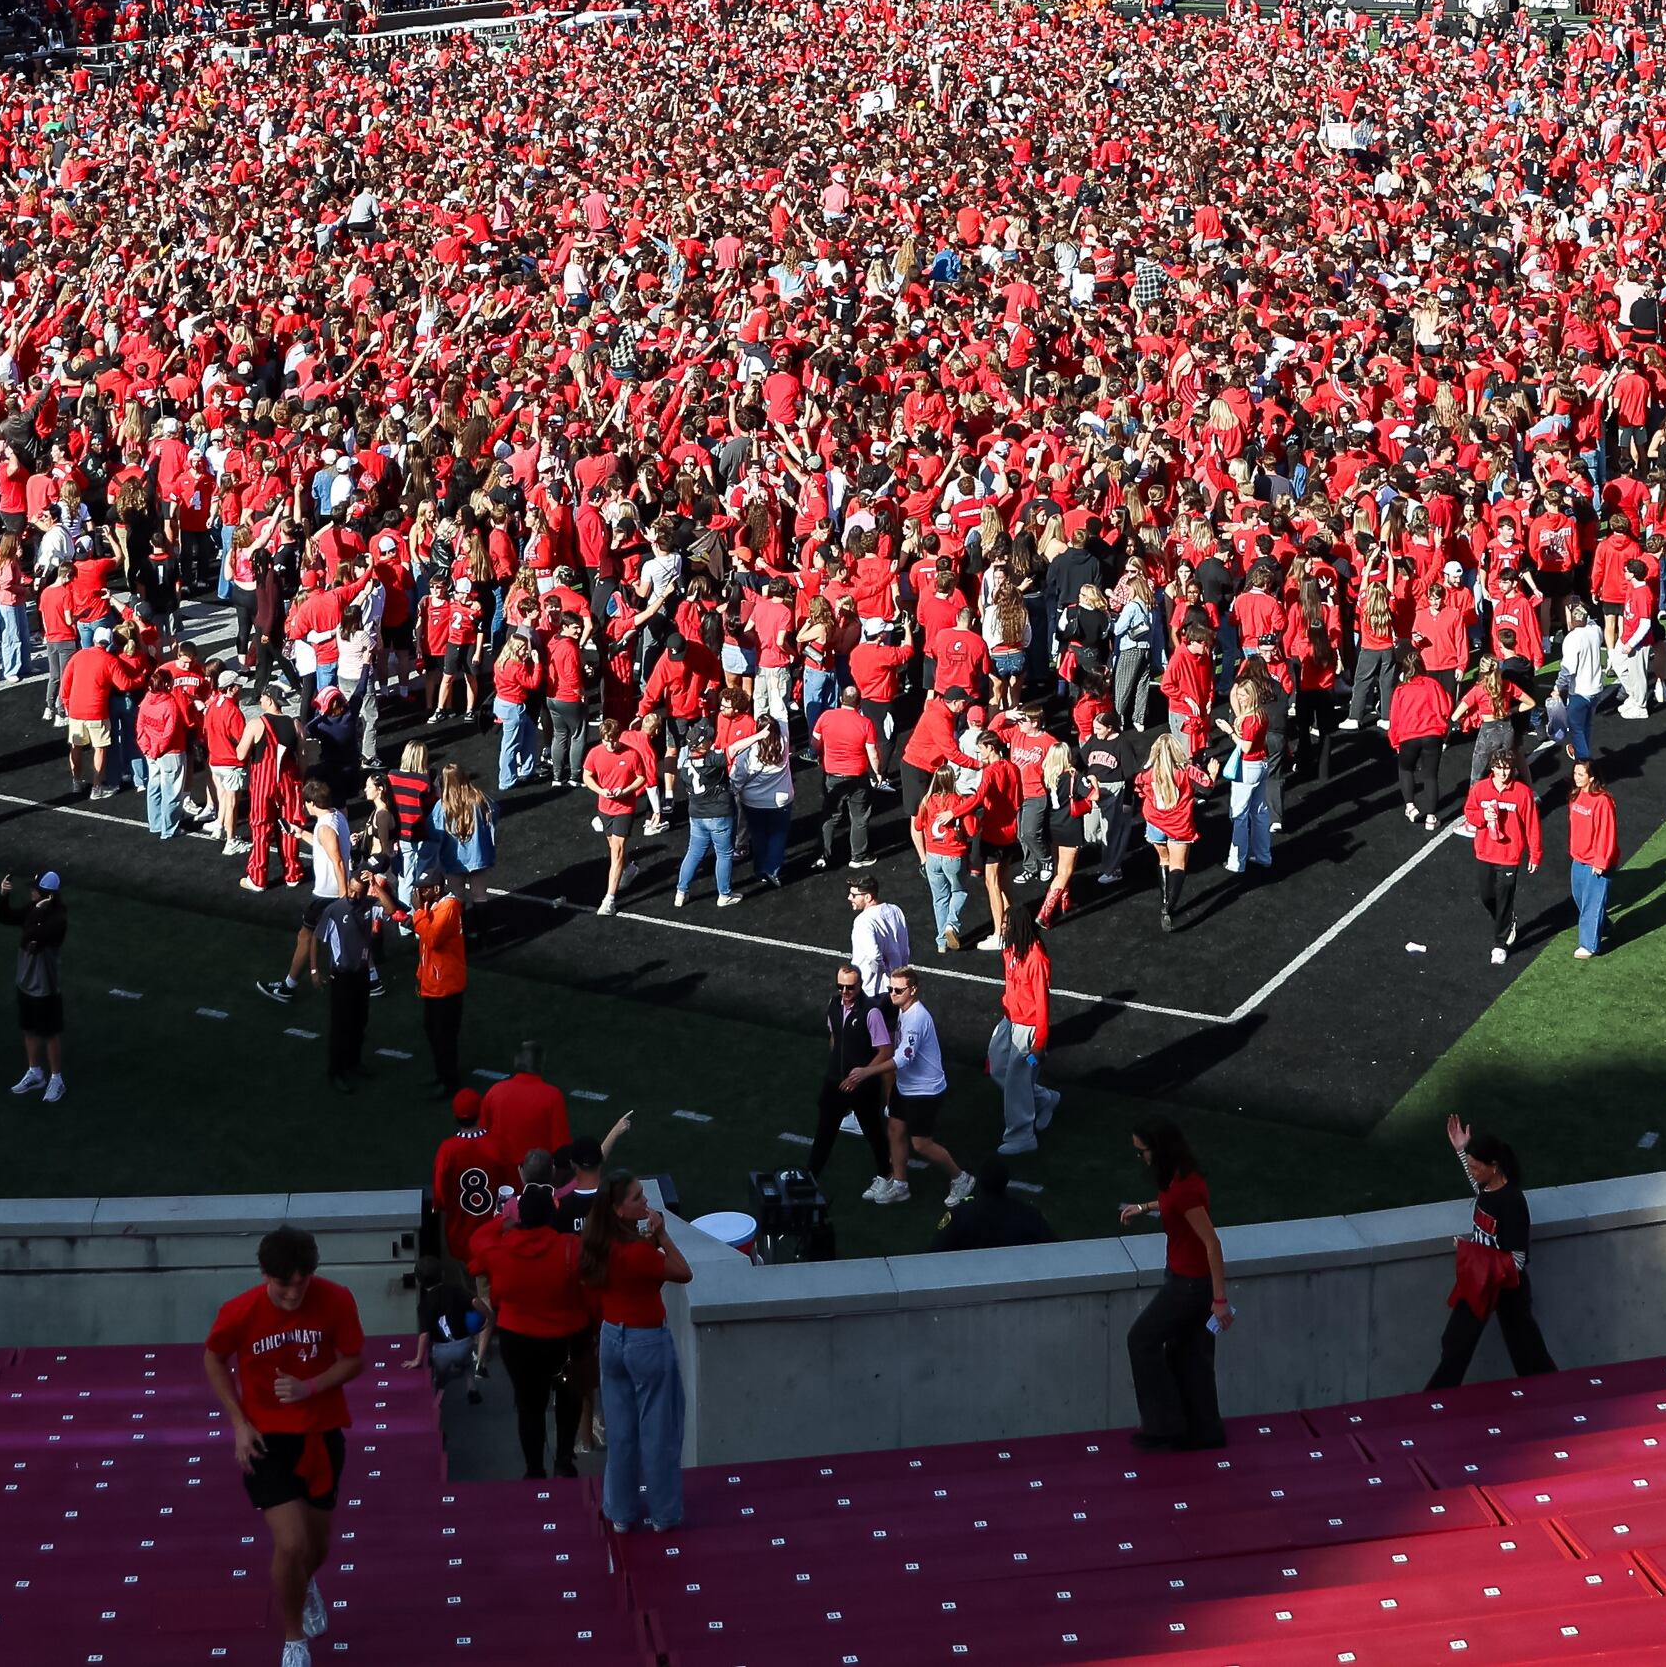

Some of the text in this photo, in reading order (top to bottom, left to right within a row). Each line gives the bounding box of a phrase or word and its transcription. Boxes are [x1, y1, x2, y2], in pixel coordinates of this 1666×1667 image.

[452, 611, 463, 630] 2
[460, 1166, 494, 1217] 8
[251, 1327, 324, 1355] CINCINNATI
